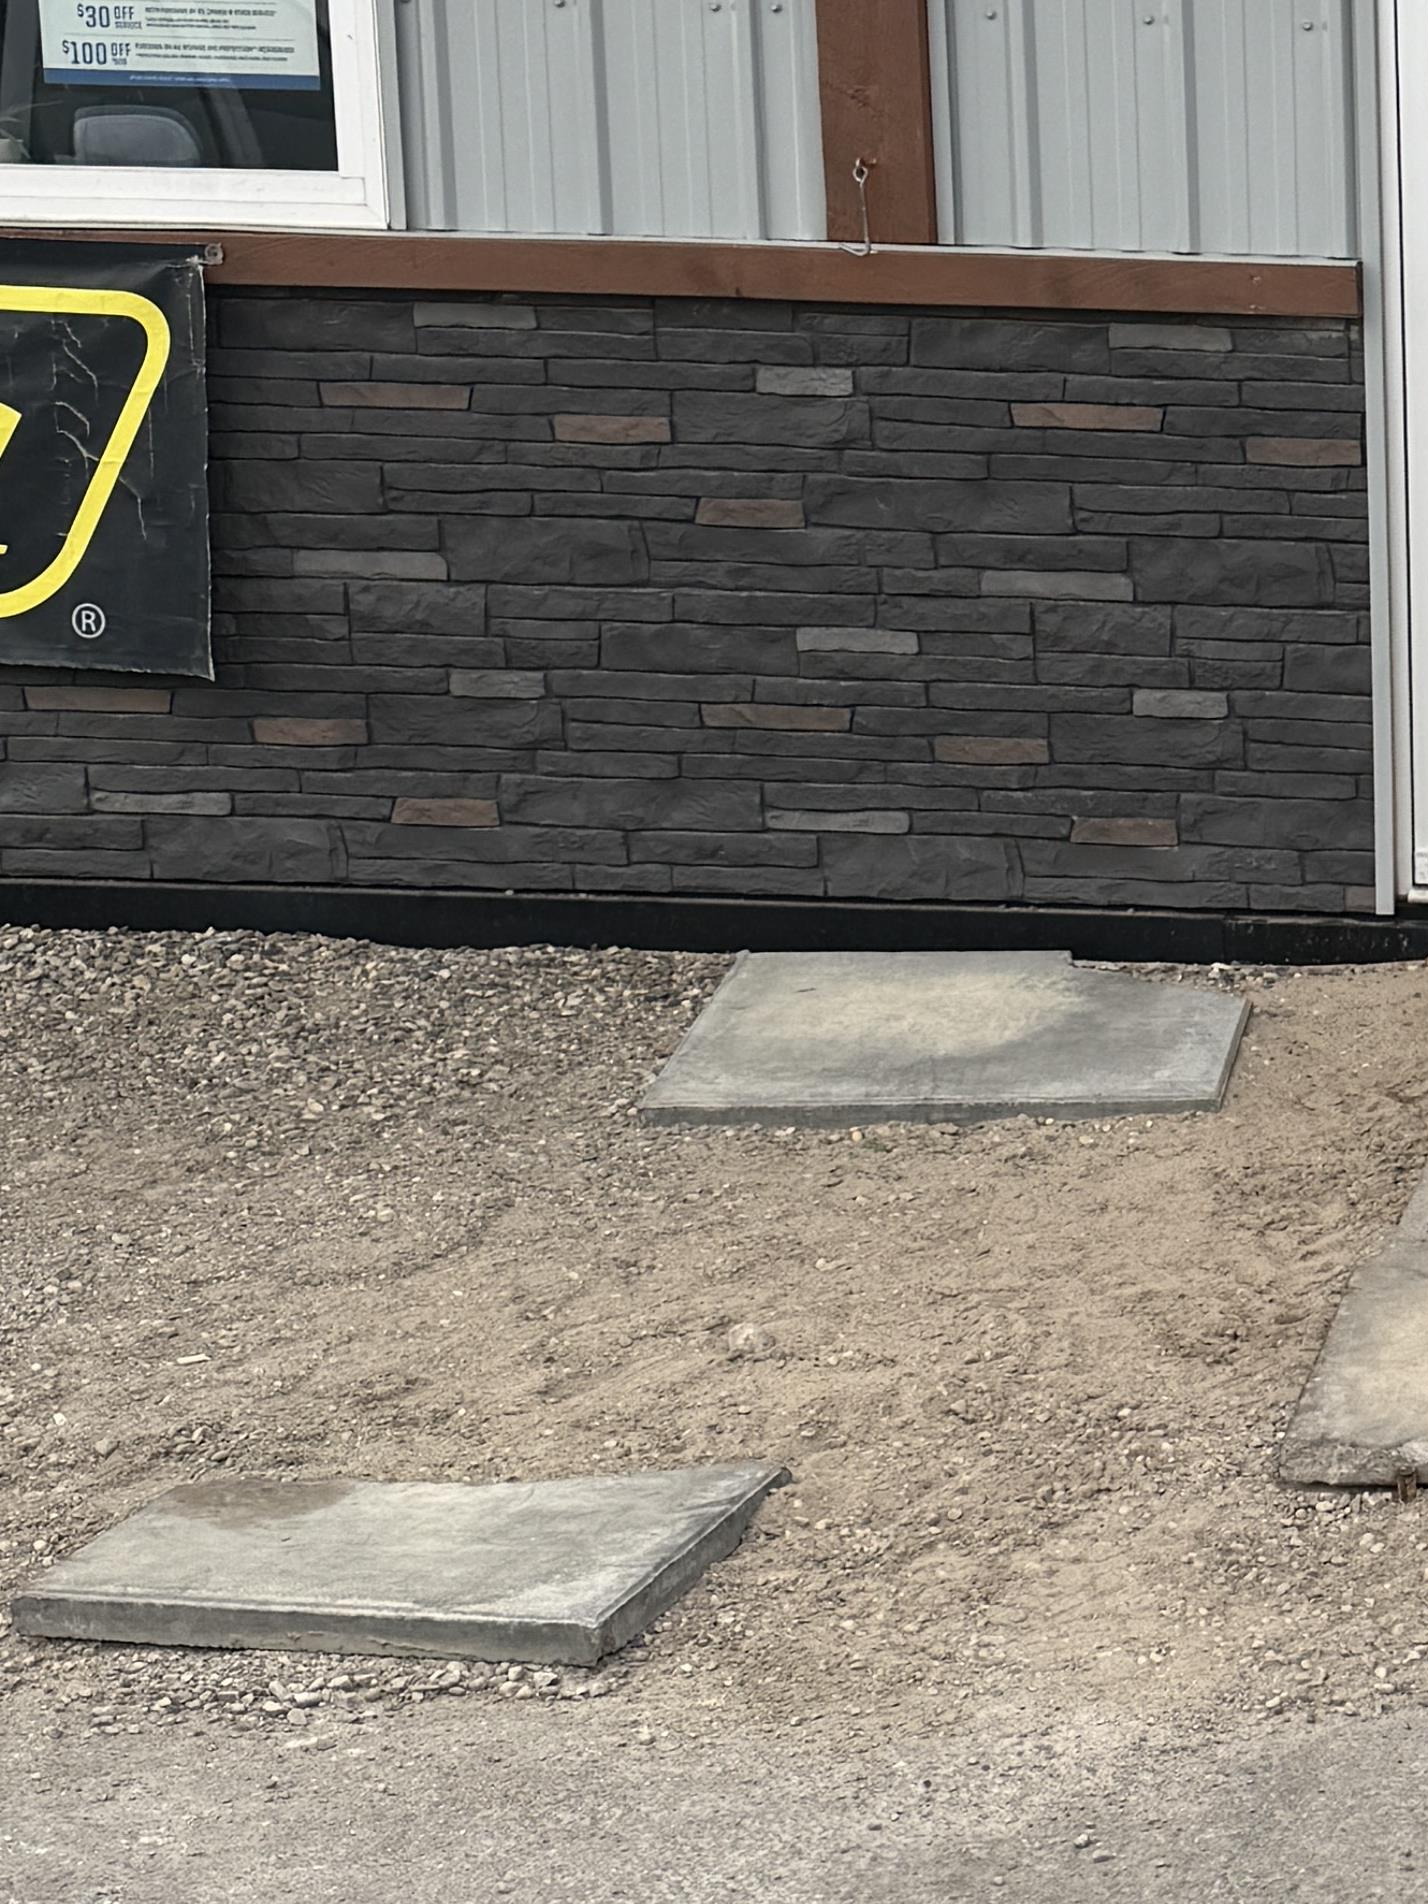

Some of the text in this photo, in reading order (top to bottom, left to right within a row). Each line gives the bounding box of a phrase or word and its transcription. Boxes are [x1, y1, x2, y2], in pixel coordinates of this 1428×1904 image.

[77, 4, 111, 28] $30
[114, 6, 134, 20] OFF
[61, 40, 107, 65] $100
[111, 43, 131, 57] OFF
